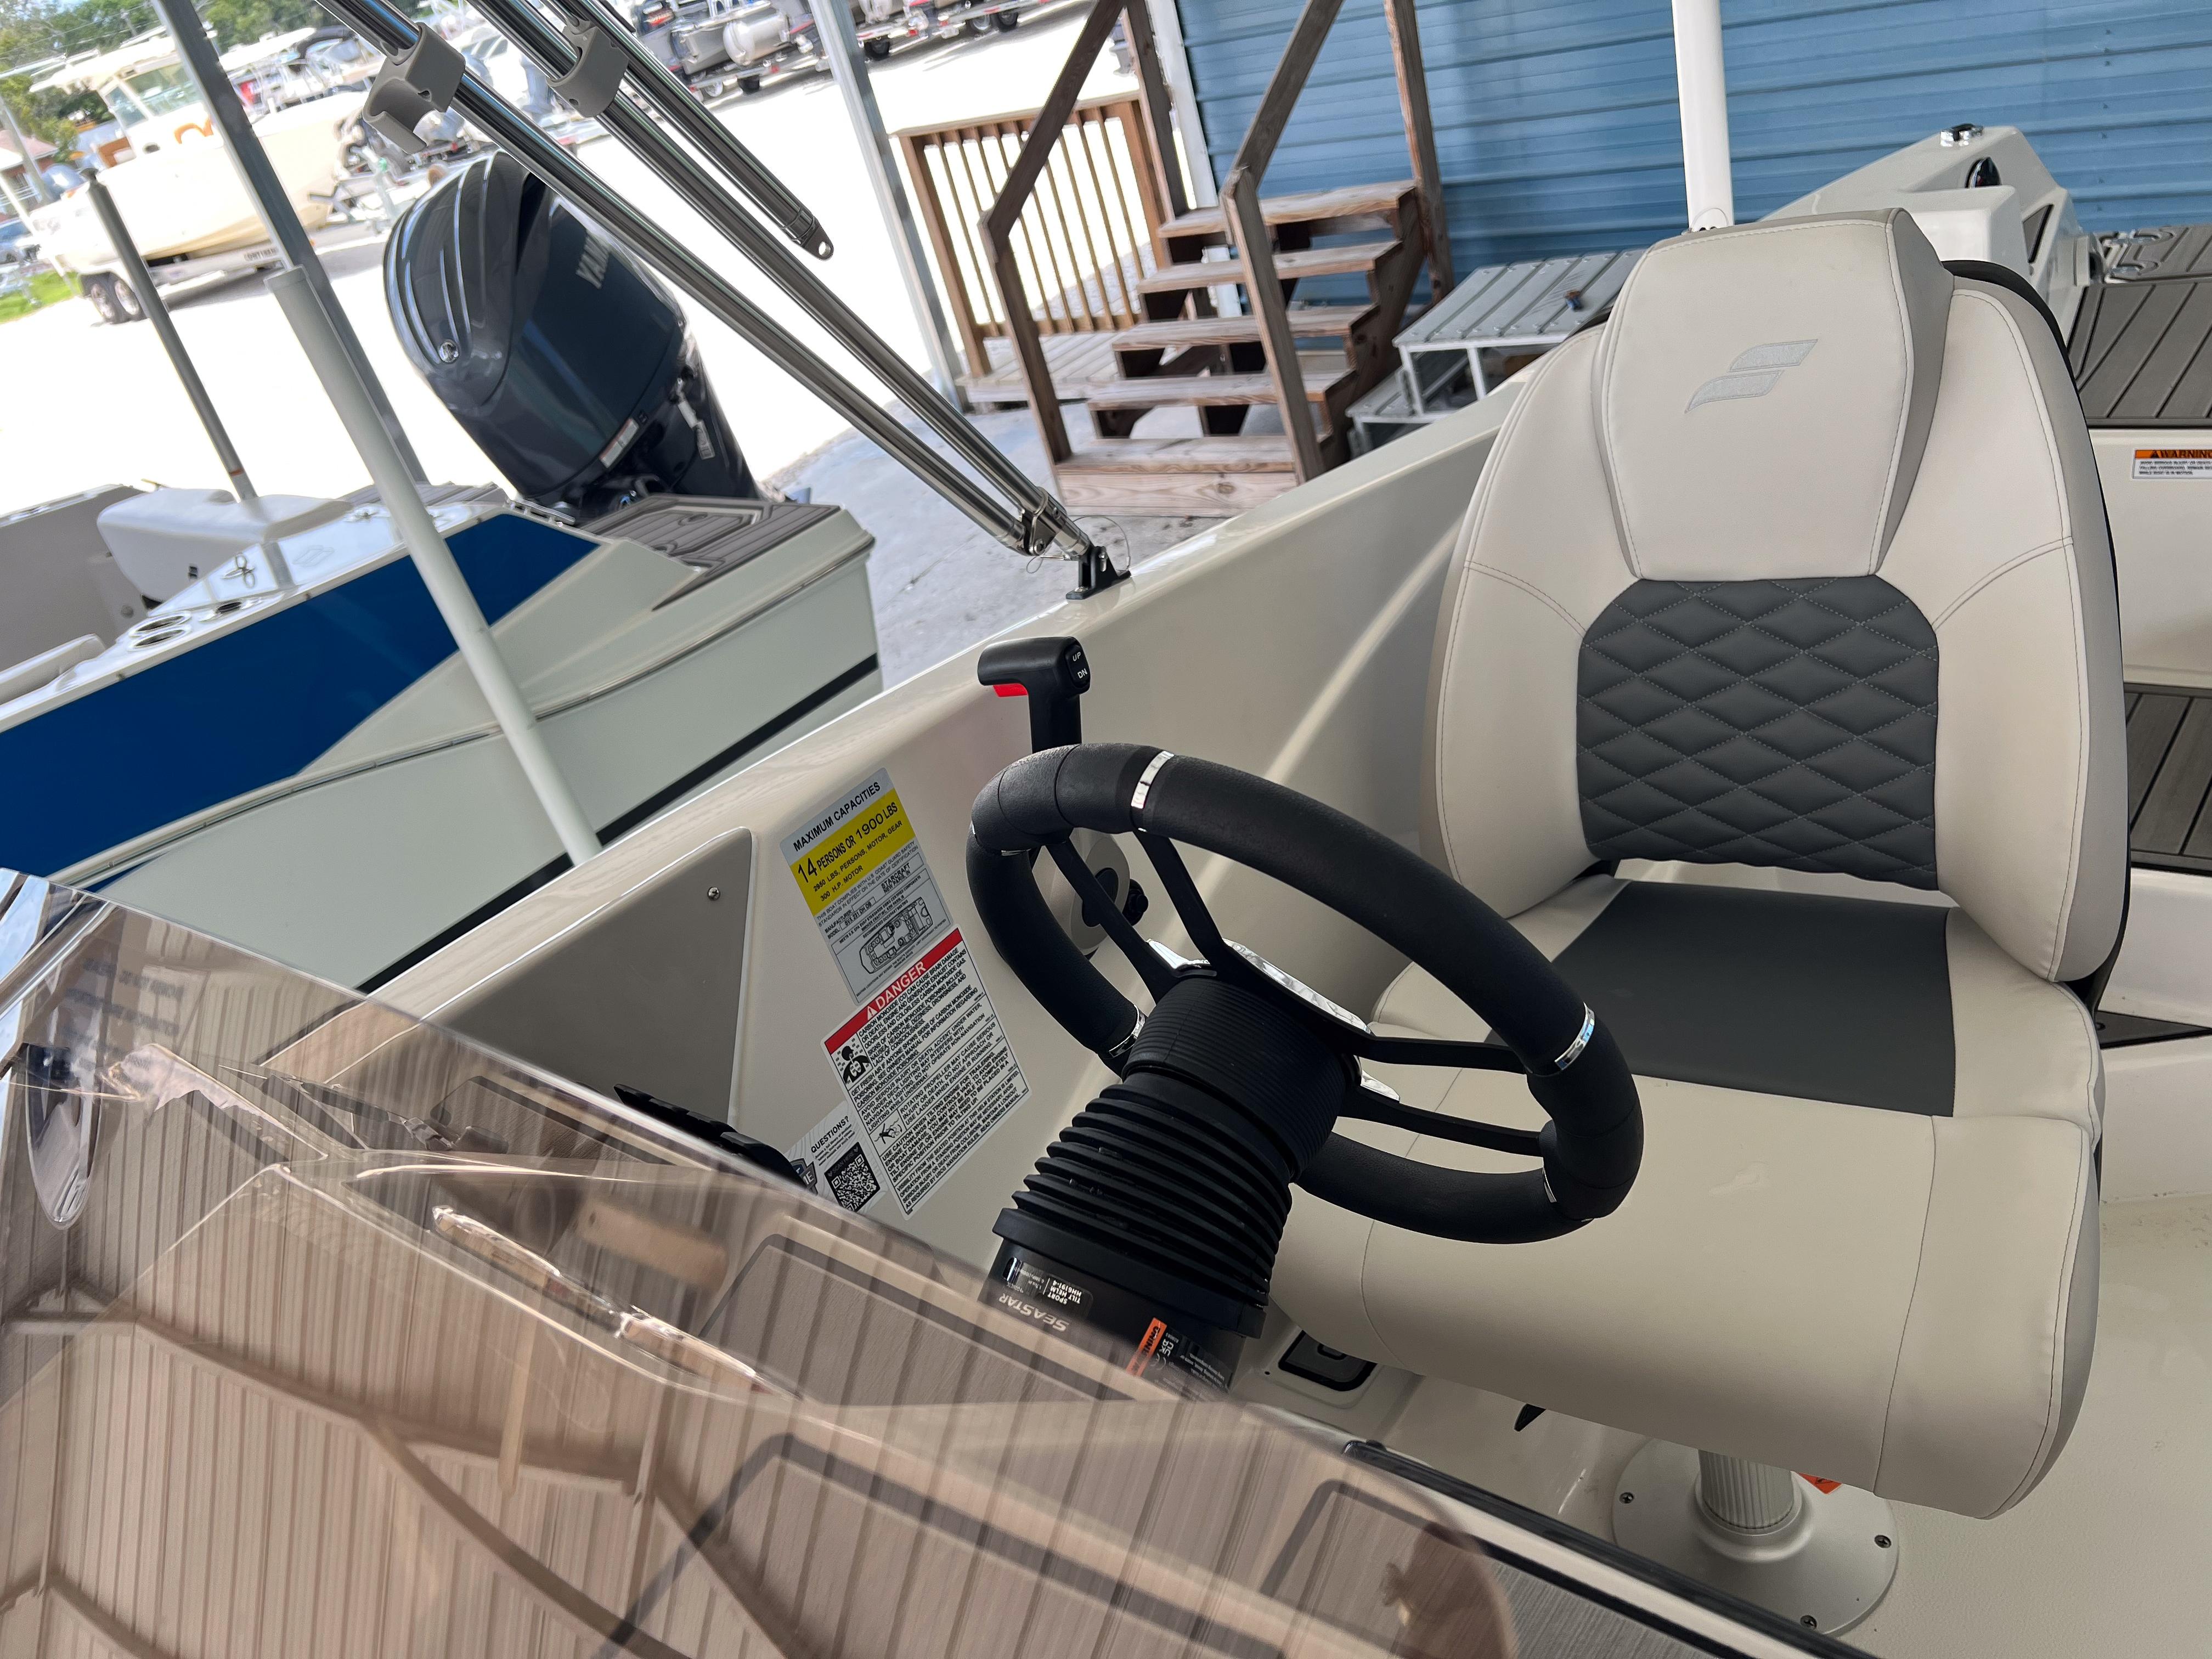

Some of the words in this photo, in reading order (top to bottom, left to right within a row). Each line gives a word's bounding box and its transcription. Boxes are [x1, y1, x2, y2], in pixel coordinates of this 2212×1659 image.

[1073, 652, 1081, 662] UP
[1077, 668, 1088, 679] DN
[793, 816, 834, 852] MAXIMUM
[833, 781, 881, 822] CAPACITIES
[795, 856, 819, 885] 14
[816, 841, 847, 871] PERSONS
[844, 834, 856, 849] OR
[855, 811, 884, 840] 1900
[882, 801, 898, 819] LBS
[826, 868, 840, 882] LBS,
[839, 847, 867, 872] PERSONS,
[867, 831, 888, 851] MOTOR,
[887, 820, 902, 835] GEAR
[820, 890, 831, 902] 300
[843, 864, 863, 883] MOTOR
[875, 871, 886, 882] DATE
[881, 862, 910, 889] STARCRAFT
[874, 960, 926, 1010] DANGER
[860, 1099, 876, 1116] AVOID
[874, 1081, 895, 1103] SERIOUS
[894, 1066, 911, 1085] INJURY
[910, 1060, 918, 1070] OR
[951, 1015, 967, 1032] UNDER
[863, 1111, 871, 1121] OR
[870, 1096, 887, 1114] UNDER
[886, 1084, 900, 1099] DECK
[899, 1065, 921, 1087] LIGHTING
[919, 1056, 930, 1068] MAY
[929, 1035, 953, 1059] INTERFERE
[952, 1025, 964, 1038] WITH
[865, 1098, 893, 1126] NAVIGATION
[914, 1071, 922, 1081] DO
[921, 1062, 932, 1074] NOT
[930, 1044, 951, 1065] OPERATE
[950, 1012, 985, 1047] NON-NAVIGATION
[900, 1088, 924, 1114] ROTATING
[923, 1063, 951, 1092] PROPELLER
[950, 1053, 961, 1066] MAY
[960, 1039, 977, 1057] CAUSE
[975, 1021, 996, 1042] SERIOUS
[902, 1101, 920, 1120] INJURY
[919, 1093, 928, 1104] OR
[944, 1070, 952, 1081] DO
[951, 1061, 962, 1074] NOT
[961, 1038, 986, 1064] APPROACH
[985, 1031, 993, 1041] OR
[868, 1109, 890, 1131] LIGHTING
[889, 1095, 904, 1112] WHILE
[905, 1113, 916, 1126] USE
[915, 1094, 935, 1116] LADDER
[934, 1081, 950, 1098] WHEN
[949, 1065, 967, 1084] ENGINE
[966, 1060, 972, 1068] IS
[810, 1115, 849, 1154] QUESTIONS?
[1047, 1291, 1068, 1305] SPORT
[1050, 1286, 1067, 1297] HELM
[1066, 1293, 1081, 1304] TILT
